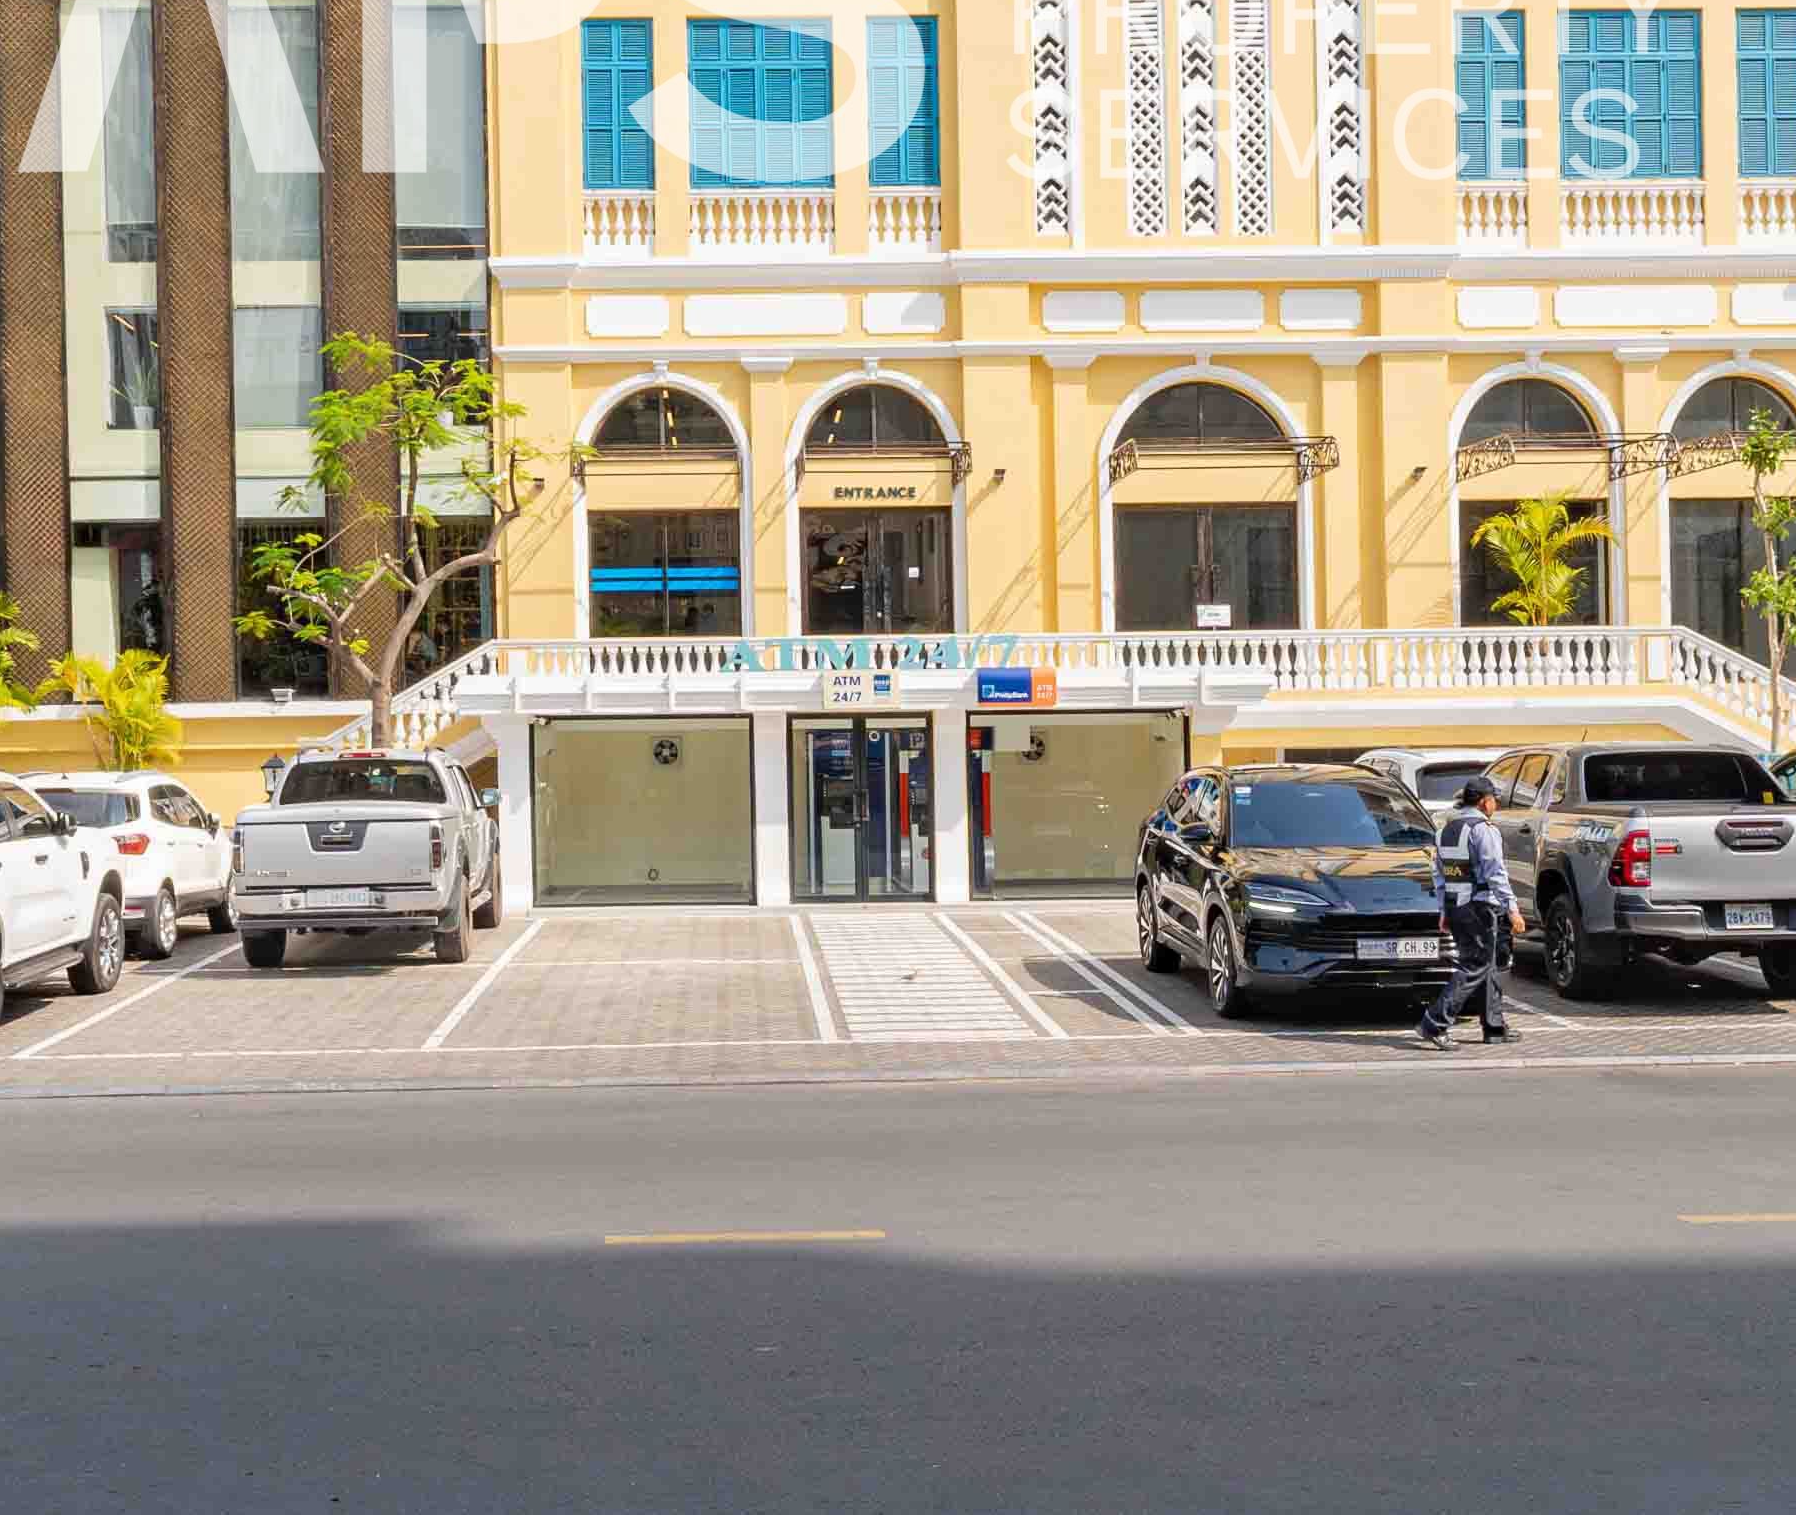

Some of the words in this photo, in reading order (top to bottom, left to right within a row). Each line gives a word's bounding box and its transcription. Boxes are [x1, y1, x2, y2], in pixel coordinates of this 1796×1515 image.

[834, 486, 917, 499] ENTRANCE
[718, 636, 876, 672] ATM
[832, 676, 861, 686] ATM
[832, 692, 862, 702] 24/7
